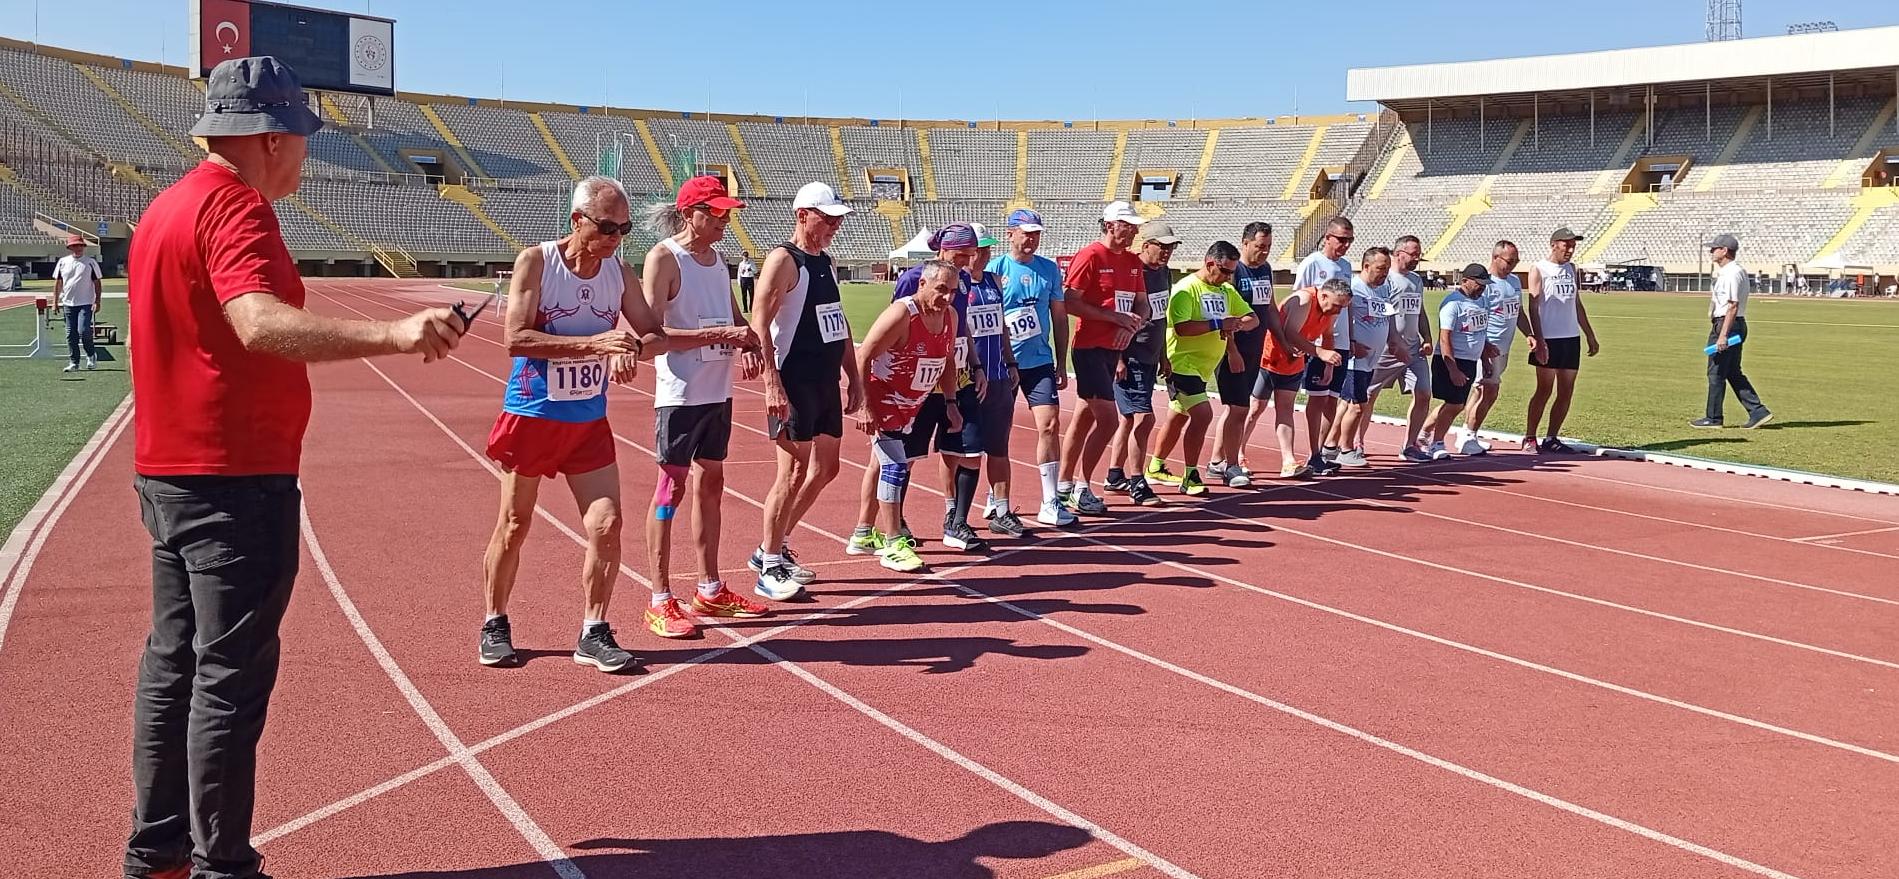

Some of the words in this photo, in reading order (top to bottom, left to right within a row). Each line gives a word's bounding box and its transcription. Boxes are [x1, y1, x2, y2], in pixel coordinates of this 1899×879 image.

[1556, 284, 1575, 294] 1173
[1117, 299, 1133, 312] 117
[1153, 299, 1169, 314] 118
[1204, 300, 1225, 313] 1183
[1402, 298, 1419, 309] 1194
[1506, 302, 1520, 314] 119
[823, 312, 845, 333] 1179
[972, 312, 999, 330] 1181
[1010, 315, 1036, 336] 198
[953, 346, 964, 361] 71
[556, 363, 603, 390] 1180
